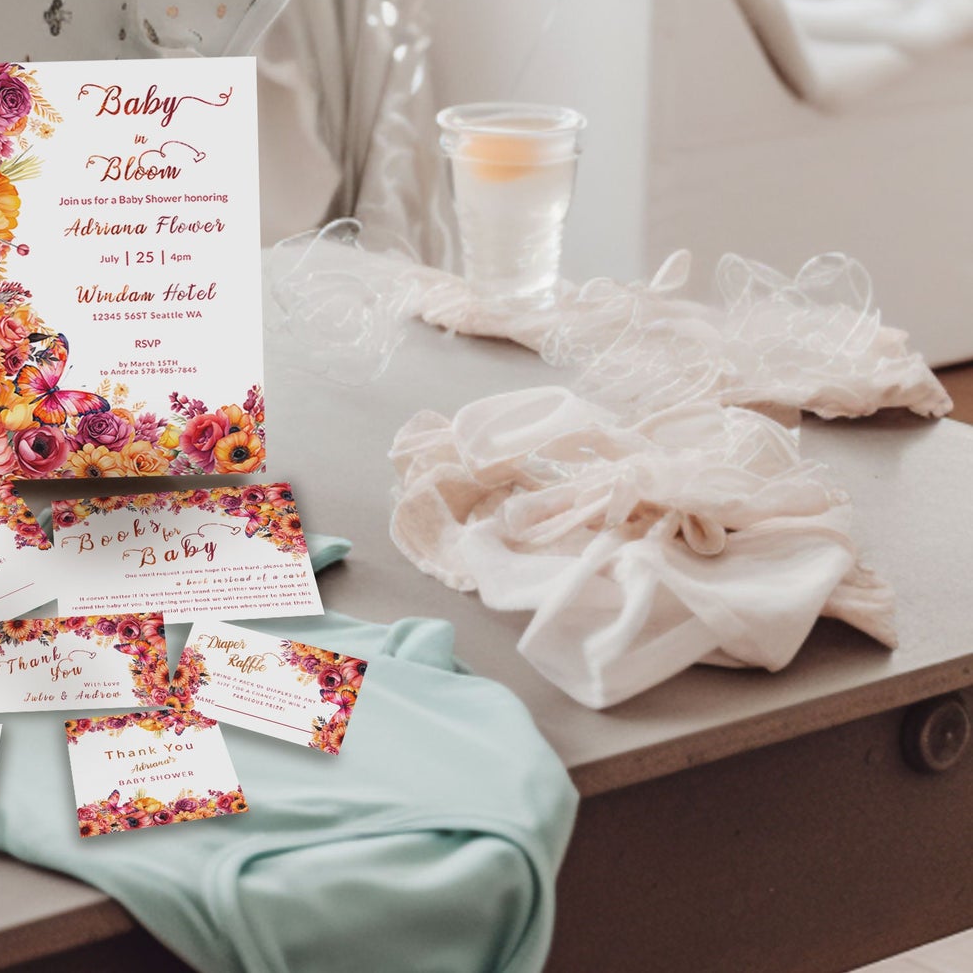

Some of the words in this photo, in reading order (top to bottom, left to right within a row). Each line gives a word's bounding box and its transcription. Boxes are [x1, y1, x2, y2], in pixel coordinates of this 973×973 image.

[80, 84, 217, 127] Baby
[134, 134, 148, 144] in
[86, 149, 189, 181] Bloom
[59, 197, 79, 206] Join
[81, 197, 92, 205] us
[94, 196, 108, 205] for
[119, 195, 143, 206] Baby
[145, 194, 182, 204] Shower
[184, 193, 228, 204] honoring
[64, 218, 147, 236] Adriana
[156, 215, 225, 234] Flower
[100, 255, 119, 264] July
[136, 251, 154, 263] 25
[170, 253, 191, 262] 4pm
[76, 284, 155, 303] Windam
[163, 282, 217, 301] Hotel
[124, 312, 147, 320] 56ST
[150, 311, 183, 319] Seattle
[135, 339, 161, 348] RSVP
[65, 518, 160, 555] Books
[162, 527, 181, 543] for
[126, 531, 221, 569] Baby
[201, 635, 247, 653] Diaper
[51, 659, 87, 682] You
[227, 653, 277, 674] Raffle
[24, 692, 55, 702] Julie
[60, 691, 68, 701] &
[75, 690, 122, 700] Andrew
[194, 695, 215, 705] NAME
[104, 746, 157, 760] Thank
[163, 743, 194, 752] You
[130, 756, 177, 774] Adriana's
[118, 777, 146, 786] BABY
[150, 770, 194, 782] SHOWER
